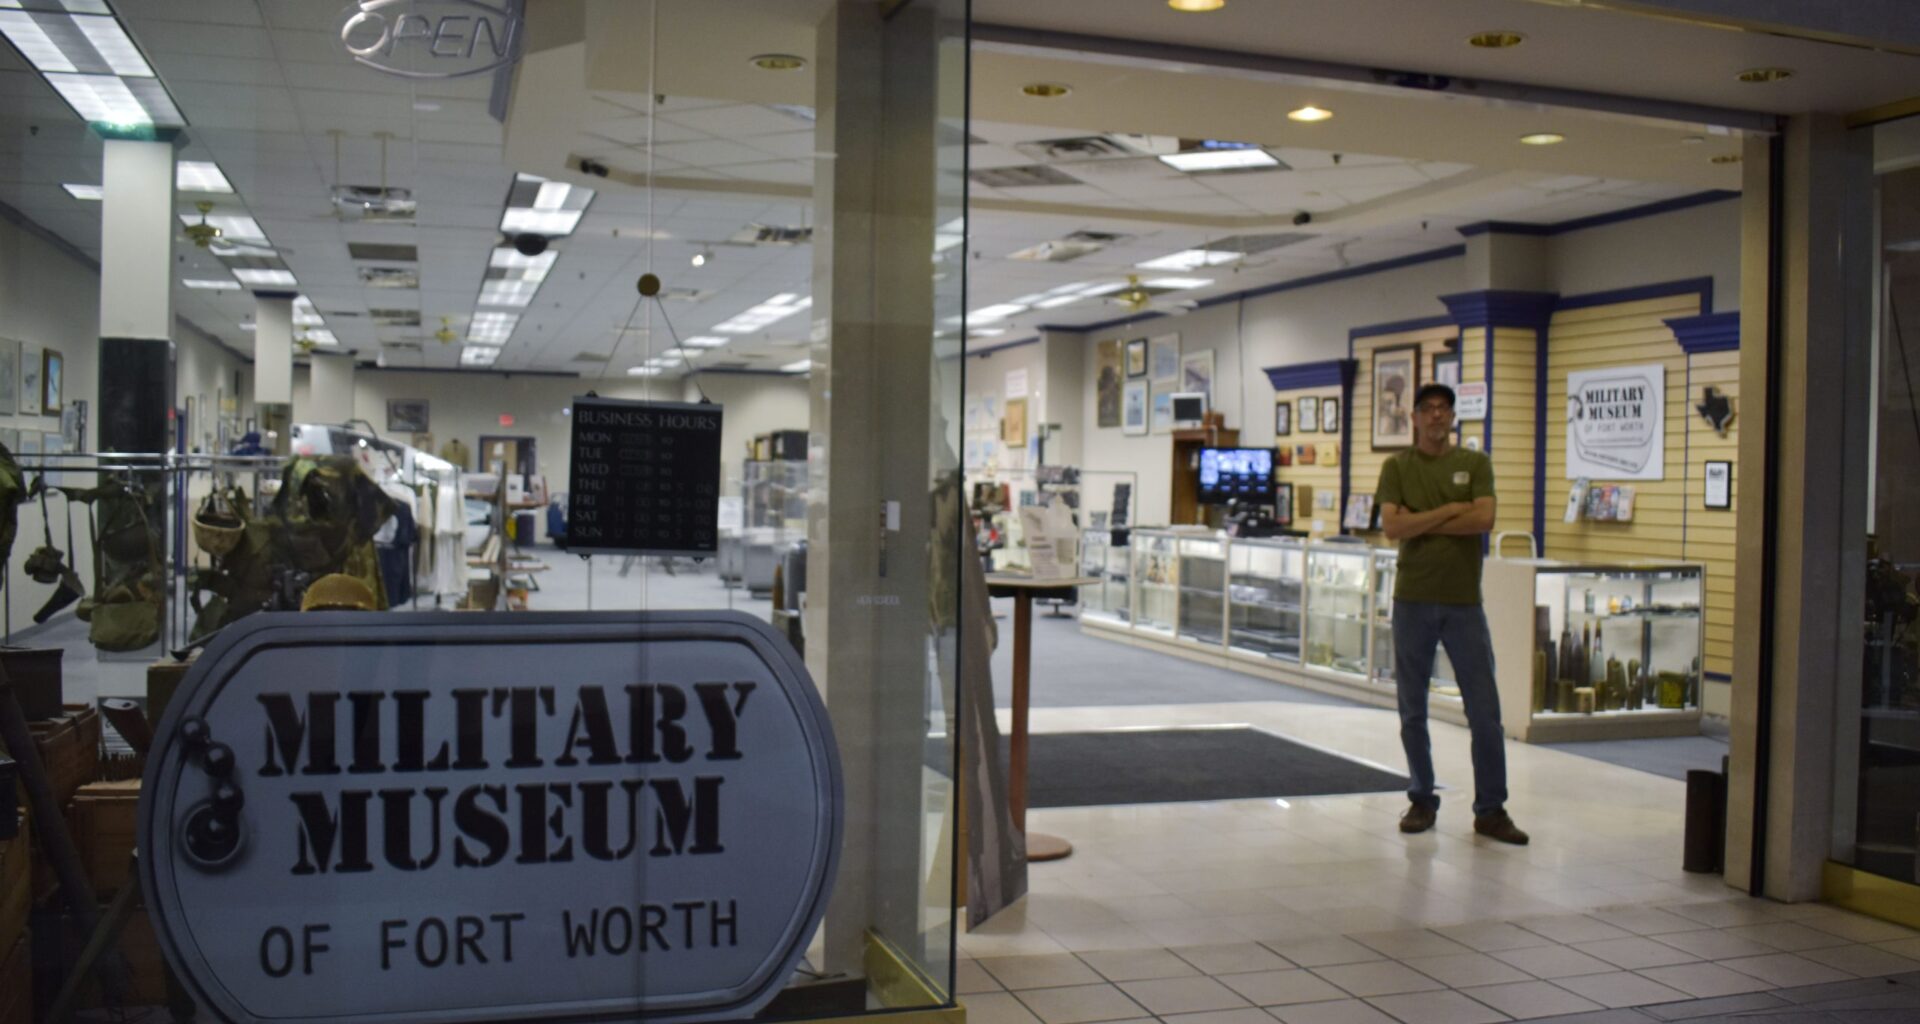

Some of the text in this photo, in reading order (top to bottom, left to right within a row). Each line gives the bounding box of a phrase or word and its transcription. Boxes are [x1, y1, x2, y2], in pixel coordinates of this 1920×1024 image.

[341, 11, 517, 58] OPEN
[1585, 386, 1645, 403] MILITARY
[1589, 403, 1642, 420] MUSEUM
[578, 410, 717, 430] BUSINESS HOURS
[579, 432, 612, 443] MON
[579, 447, 603, 458] TUE
[578, 463, 609, 474] WED
[578, 478, 605, 490] THU
[576, 494, 596, 505] FRI
[575, 510, 598, 521] SAT
[575, 526, 603, 537] SUN
[257, 681, 757, 778] MILITARY
[290, 775, 725, 875] MUSEUM
[259, 899, 739, 979] OF FORT WORTH
